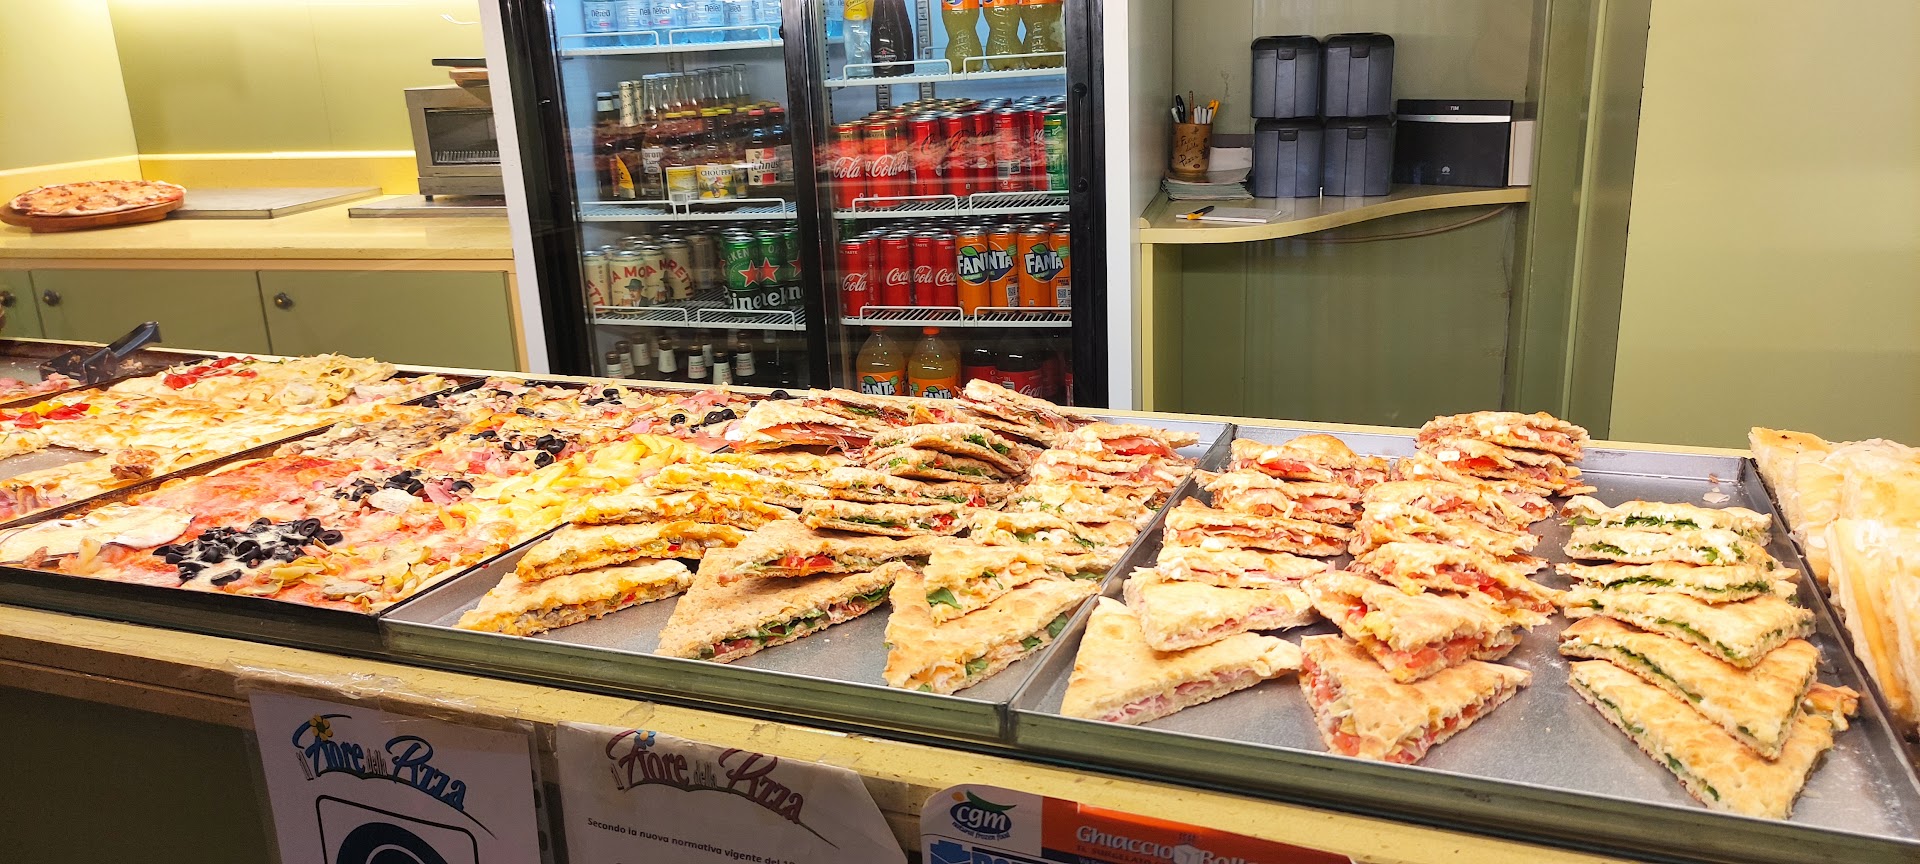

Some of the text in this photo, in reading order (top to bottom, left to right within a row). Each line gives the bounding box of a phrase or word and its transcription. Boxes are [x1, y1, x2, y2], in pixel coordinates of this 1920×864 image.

[842, 273, 867, 292] Cola
[860, 381, 896, 395] FANTA
[292, 714, 365, 777] Fiore
[605, 729, 689, 788] Fiore
[956, 806, 1006, 830] cgm
[587, 817, 626, 834] Secondo
[628, 827, 637, 836] la
[639, 831, 669, 843] nuova
[672, 838, 722, 855] normativa
[724, 849, 762, 863] vigente
[1076, 825, 1174, 859] Ghiaccio
